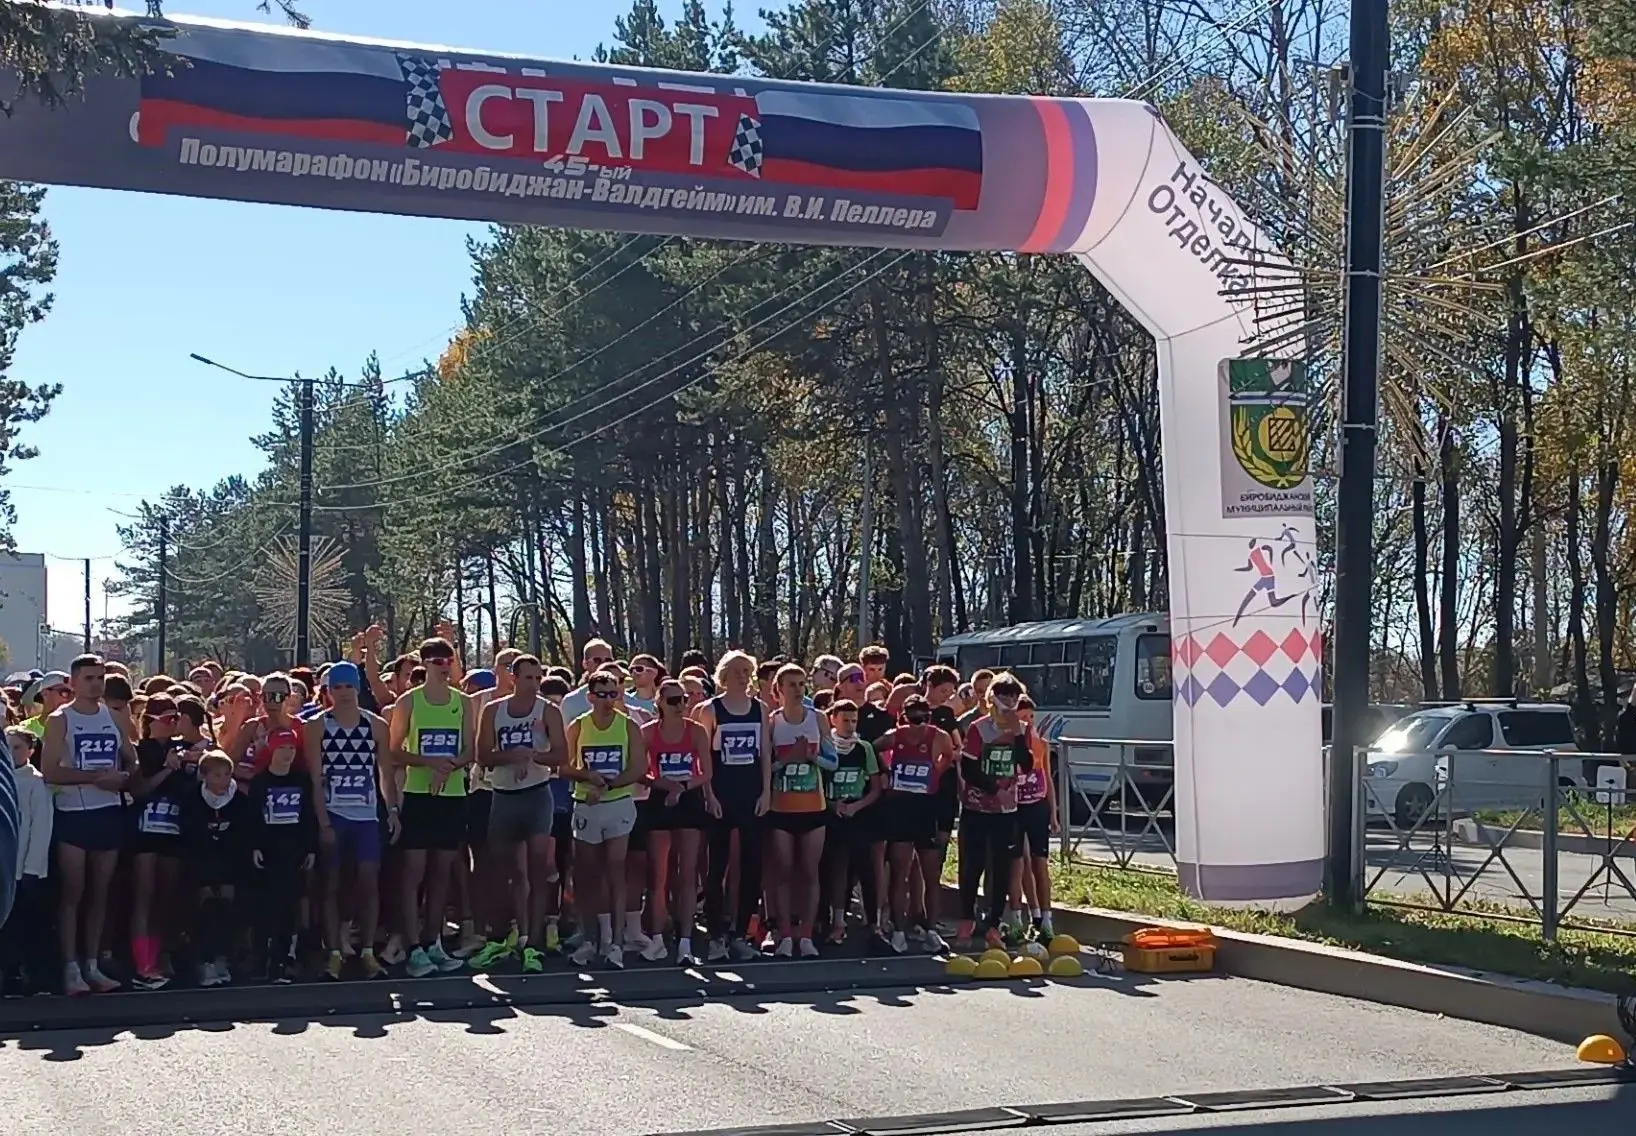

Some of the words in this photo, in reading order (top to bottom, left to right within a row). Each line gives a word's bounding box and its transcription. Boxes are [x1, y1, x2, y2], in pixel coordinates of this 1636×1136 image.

[466, 84, 719, 166] СТАРТ
[543, 154, 632, 180] 45-ый
[180, 138, 390, 182] Полумарафон
[738, 195, 778, 217] им.
[782, 197, 824, 220] В.И.
[830, 199, 937, 229] Пеллера
[420, 734, 457, 746] 293
[500, 731, 532, 745] 191
[80, 739, 115, 753] 212
[330, 775, 366, 787] 312
[266, 793, 300, 806] 142
